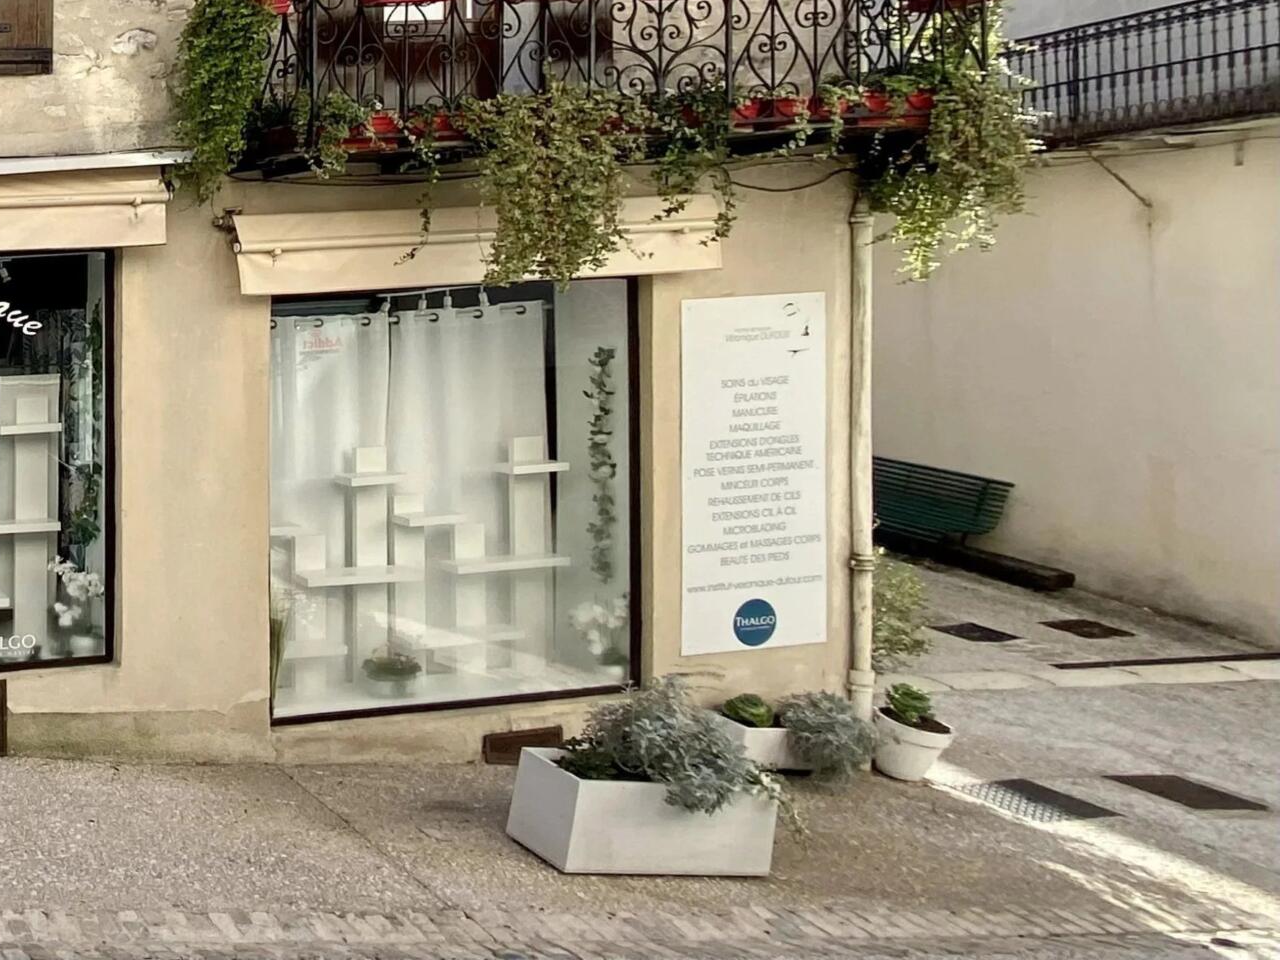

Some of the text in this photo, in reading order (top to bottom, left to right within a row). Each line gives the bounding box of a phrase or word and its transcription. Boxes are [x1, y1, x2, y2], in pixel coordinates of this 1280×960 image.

[721, 378, 746, 389] SOINS
[760, 375, 790, 386] VISAGE
[732, 406, 779, 418] MANUCURE
[729, 421, 782, 433] MAQUILLAGE
[709, 437, 758, 450] EXTENSIONS
[706, 449, 753, 462] TECHNIQUE
[693, 459, 814, 478] POSE VERNIS SEMI-PERMANENT
[721, 476, 789, 490] MINCEUR CORPS
[770, 492, 782, 502] DE
[783, 490, 801, 500] CILS
[712, 509, 760, 522] EXTENSIONS
[761, 508, 775, 517] CIL
[784, 506, 797, 515] CIL
[723, 521, 787, 535] MICROBLADING
[687, 541, 738, 554] GOMMAGES
[750, 536, 793, 549] MASSAGES
[793, 534, 822, 545] CORPS
[750, 553, 766, 565] DES
[767, 551, 790, 562] PIEDS
[735, 615, 776, 627] THALGO
